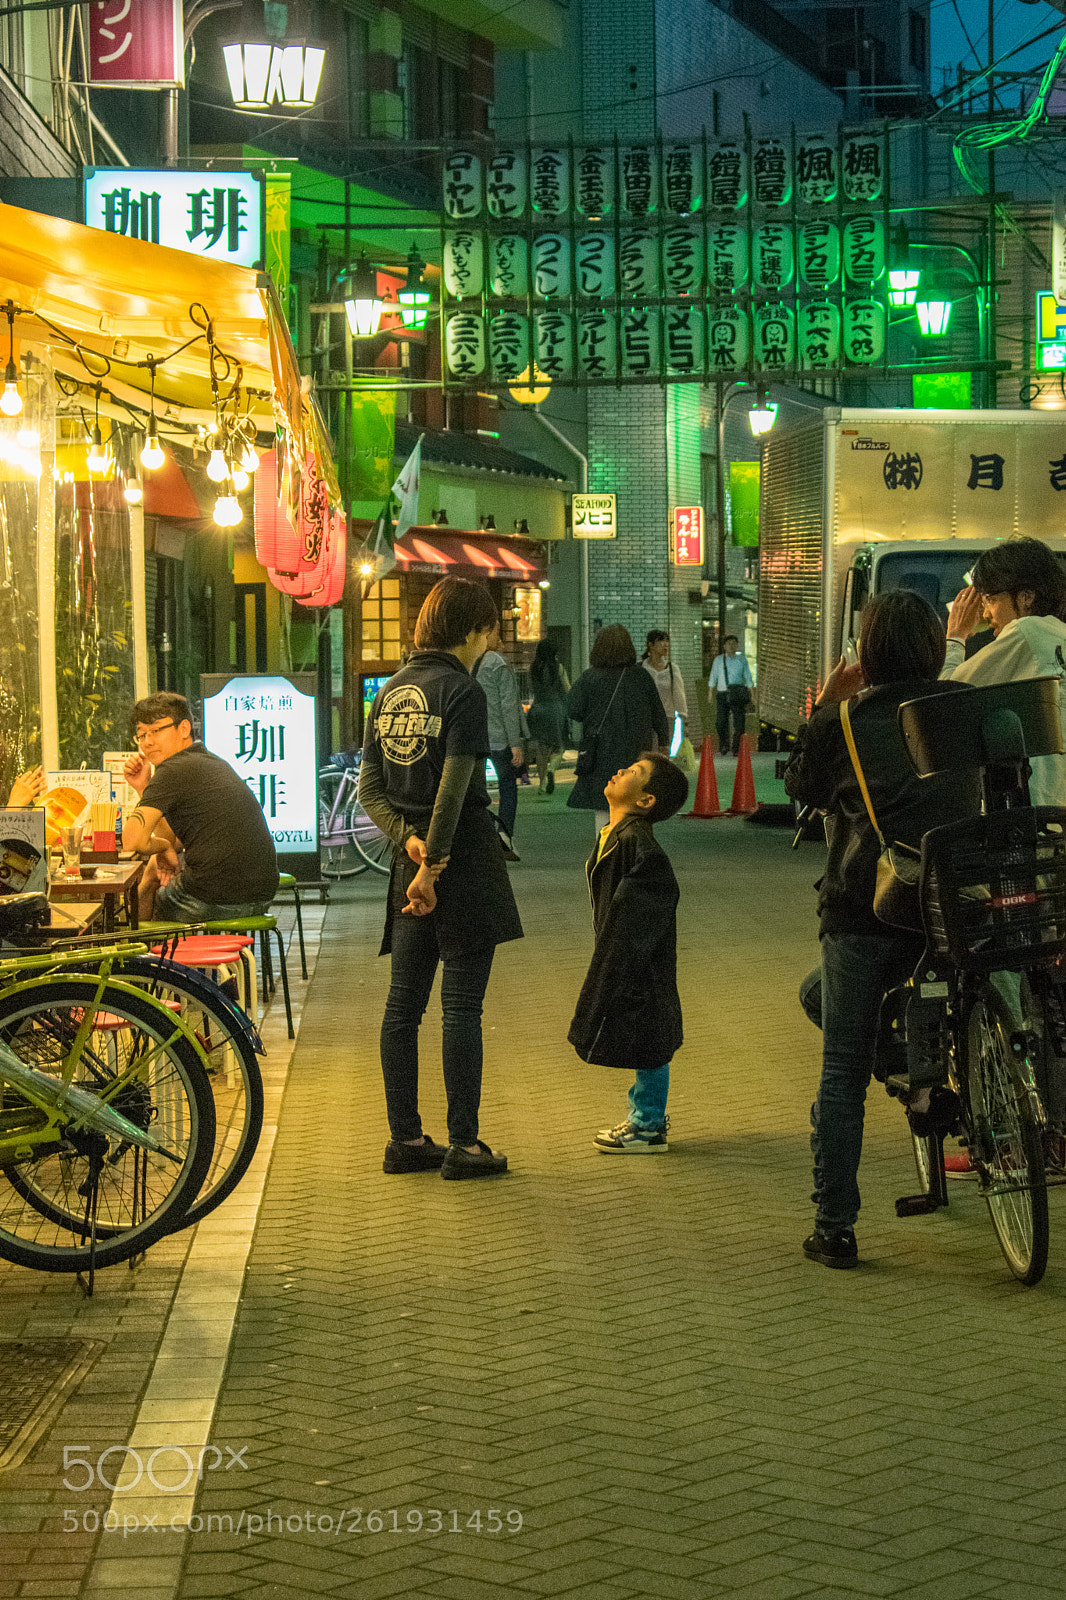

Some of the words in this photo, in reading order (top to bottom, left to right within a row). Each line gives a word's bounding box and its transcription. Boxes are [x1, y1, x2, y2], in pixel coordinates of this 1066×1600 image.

[446, 155, 474, 214] ローヤル
[488, 156, 516, 214] ローヤル
[535, 238, 561, 294] つくし
[580, 238, 605, 293] つくし
[713, 229, 737, 287] ヤマト運輸
[759, 226, 783, 284] ヤマト運輸
[803, 223, 829, 282] ヨシカミ
[850, 221, 875, 278] ヨシカミ
[450, 317, 479, 374] ユニバース
[492, 317, 522, 374] ユニバース
[539, 315, 565, 372] ラルース
[580, 314, 606, 372] ラルース
[625, 314, 650, 370] メヒコ
[669, 313, 693, 368] メヒコ
[575, 499, 612, 509] SEAFOOD
[575, 511, 613, 526] メヒコ
[225, 695, 293, 712] 自家焙煎
[235, 719, 287, 818] 珈琲
